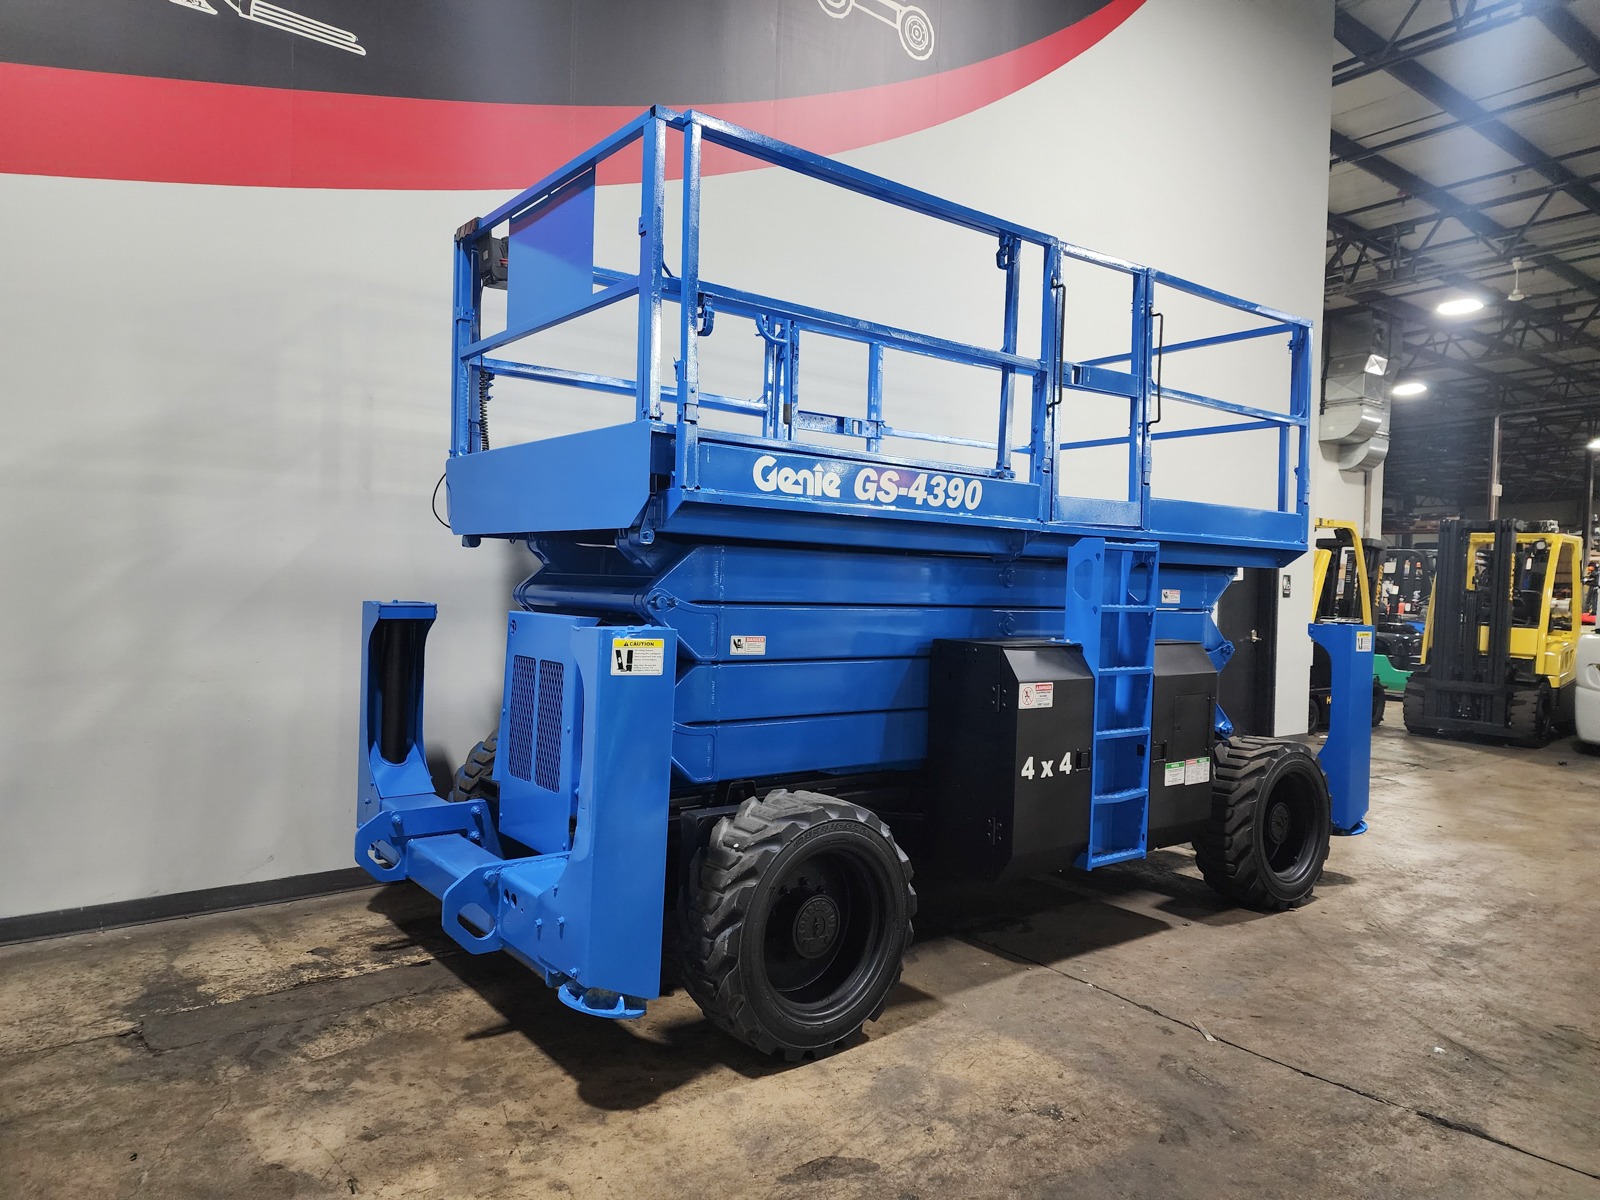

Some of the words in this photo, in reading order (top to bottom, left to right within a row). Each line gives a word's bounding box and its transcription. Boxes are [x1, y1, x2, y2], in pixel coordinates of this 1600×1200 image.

[752, 455, 841, 498] Genie
[854, 467, 983, 510] GS-4390
[1021, 756, 1035, 780] 4
[1040, 760, 1054, 778] x
[1059, 751, 1072, 774] 4
